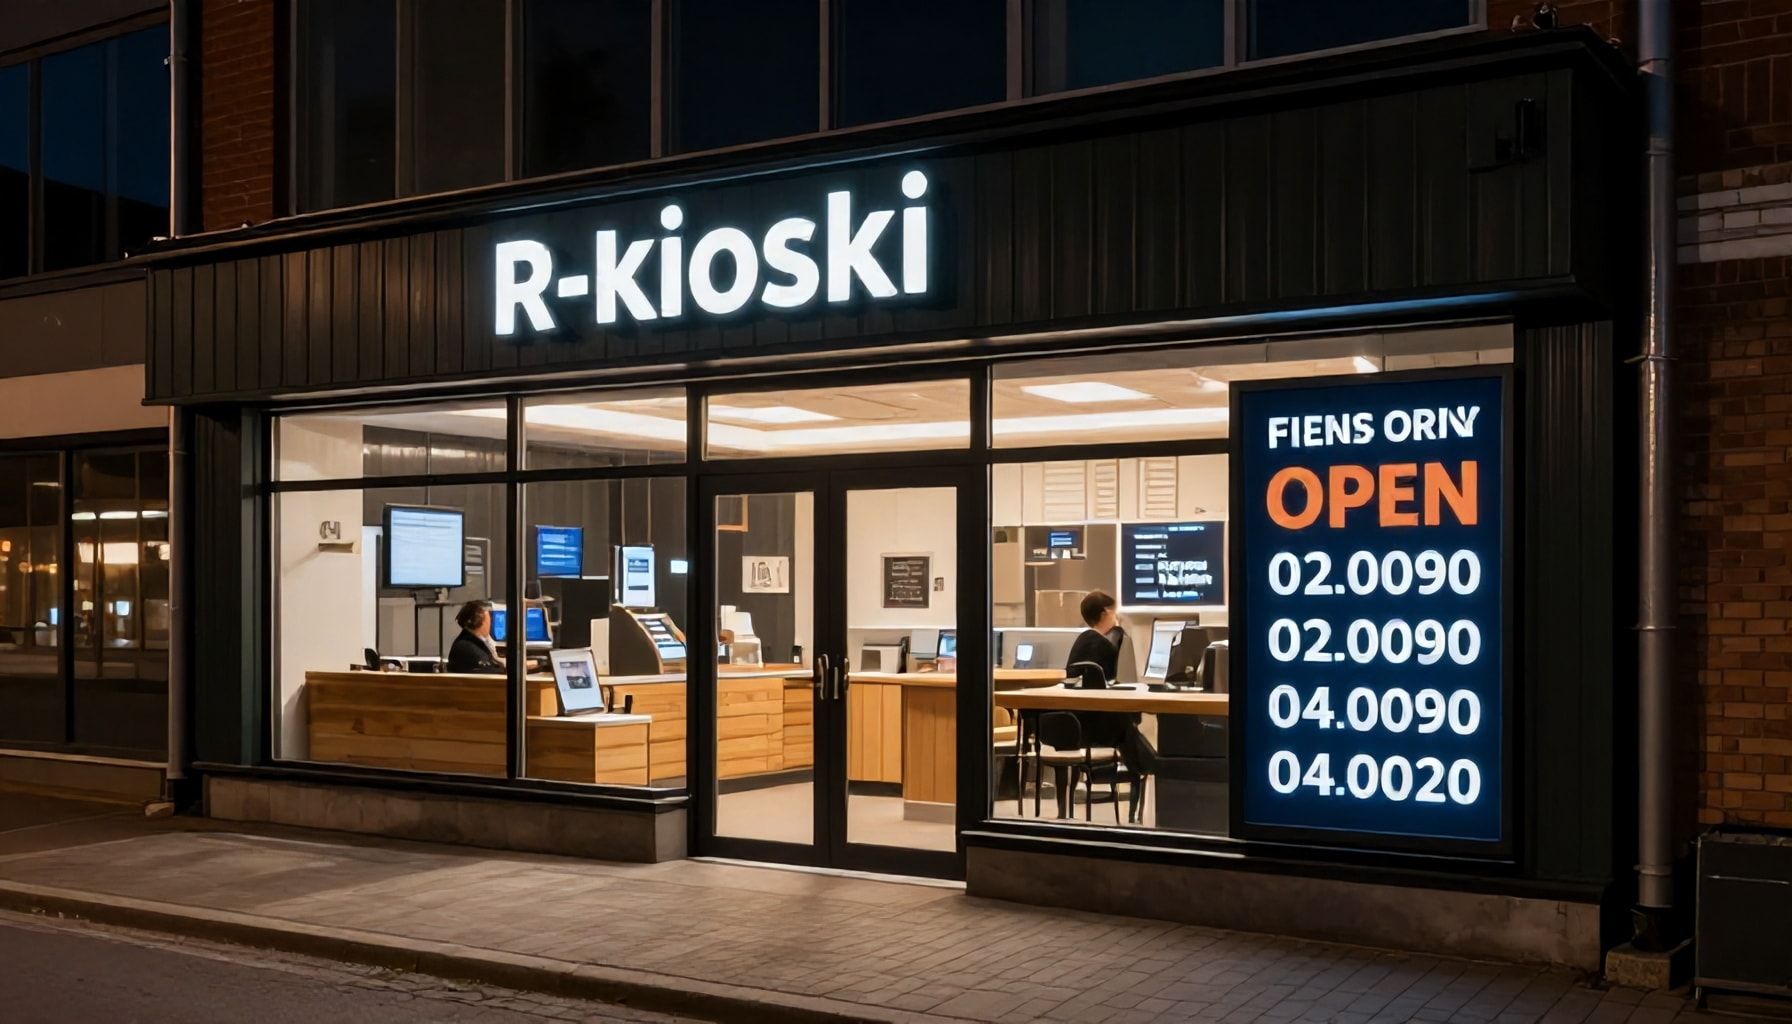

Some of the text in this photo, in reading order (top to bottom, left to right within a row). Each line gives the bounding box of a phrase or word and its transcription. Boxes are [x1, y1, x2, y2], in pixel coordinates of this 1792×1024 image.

[495, 170, 929, 336] R-kioski
[1268, 412, 1375, 449] FIENS
[1266, 460, 1478, 530] OPEN
[1268, 549, 1481, 596] 02.0090
[1268, 618, 1481, 665] 02.0090
[1268, 684, 1481, 736] 04.0090
[1268, 750, 1481, 805] 04.0020
